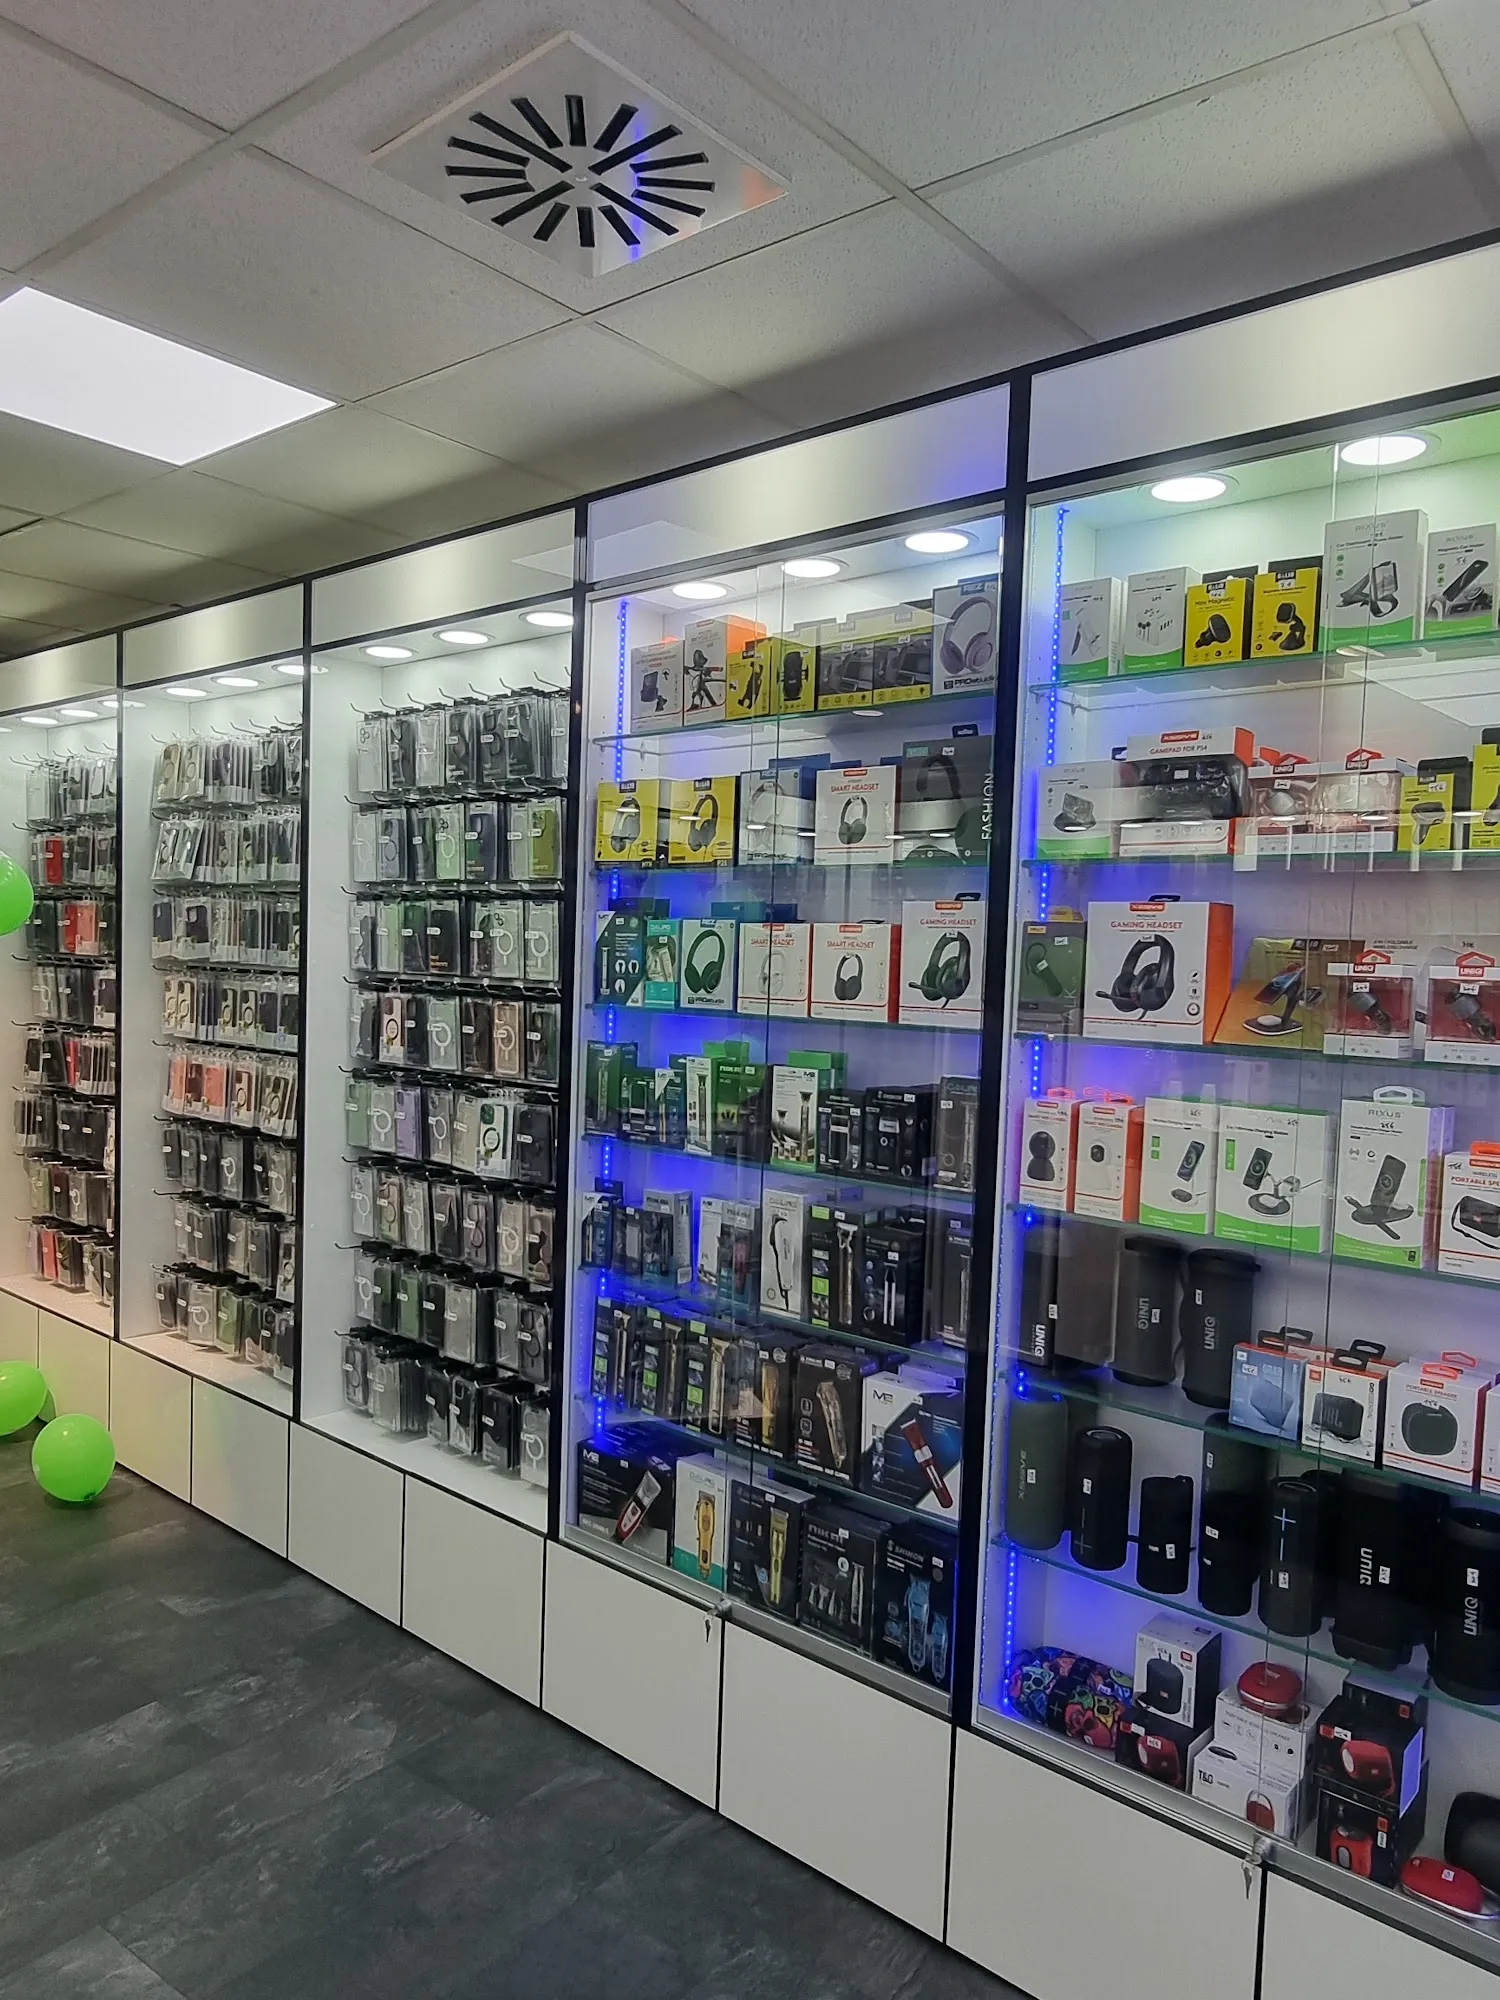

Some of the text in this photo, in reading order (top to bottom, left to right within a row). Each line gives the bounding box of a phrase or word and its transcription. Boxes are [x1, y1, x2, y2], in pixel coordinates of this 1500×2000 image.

[830, 783, 879, 793] SMART HEADSET
[981, 772, 994, 841] FASHION
[919, 918, 977, 926] GAMING HEADSET
[1110, 920, 1183, 929] GAMING HEADSET
[826, 940, 875, 949] SMART HEADSET
[1460, 967, 1482, 976] UNIQ
[1367, 1109, 1402, 1118] RIXUS
[1450, 1176, 1486, 1185] PORTABLE
[1139, 1297, 1149, 1330] UNIQ
[1035, 1324, 1046, 1358] UNIQ
[1204, 1316, 1216, 1350] UNIQ
[1322, 1404, 1344, 1429] JBL
[1360, 1547, 1373, 1586] UNIQ
[1463, 1596, 1479, 1637] UNIQ
